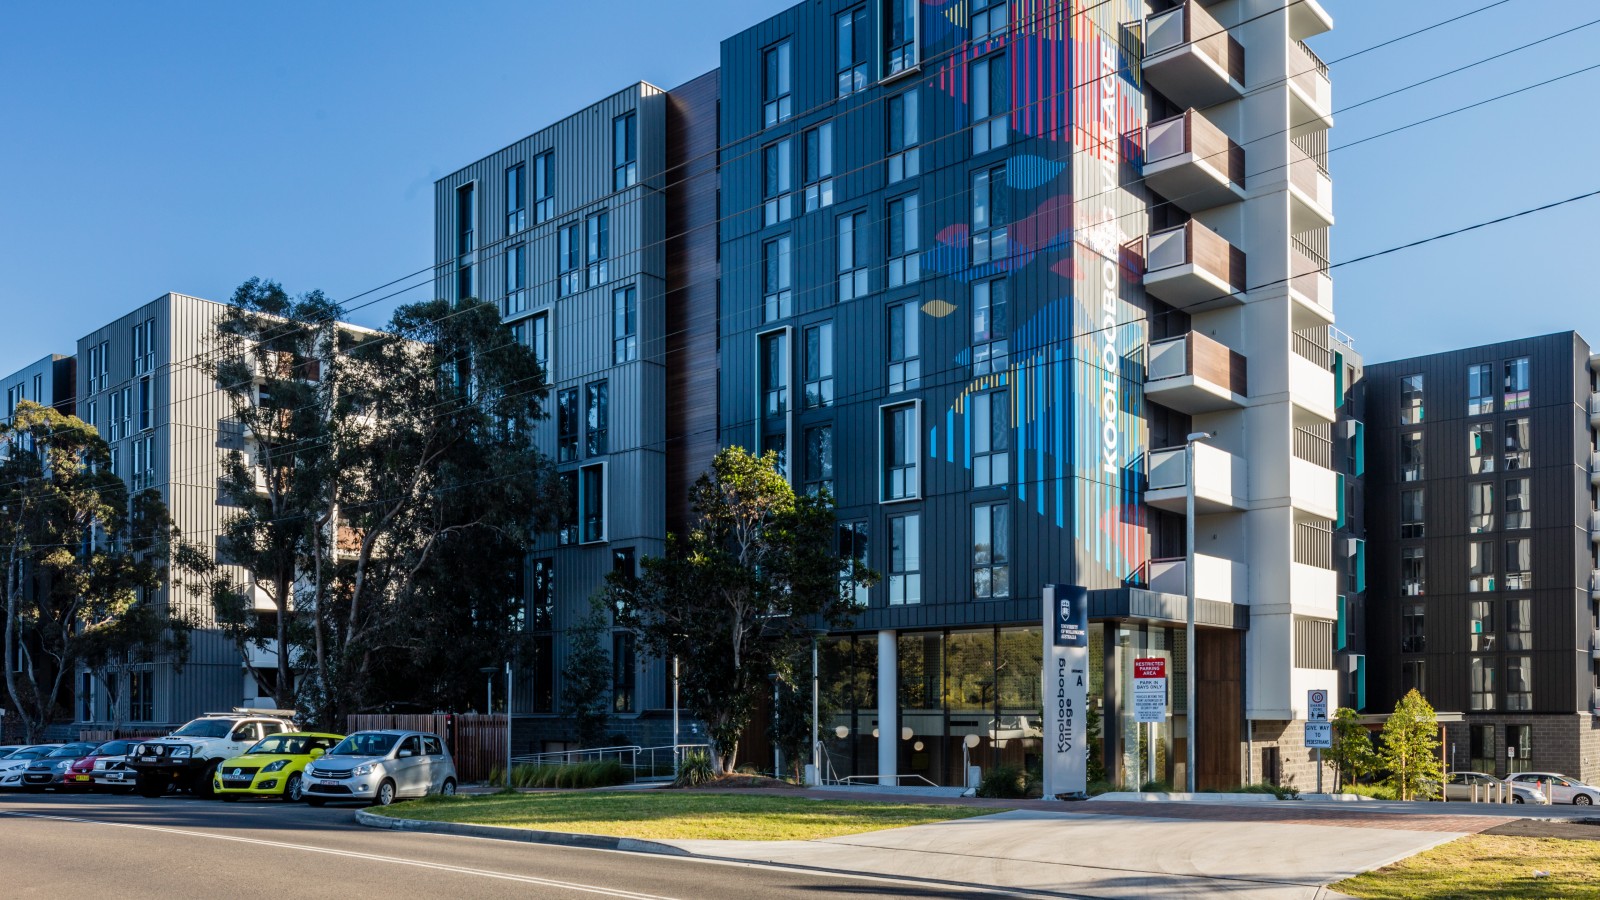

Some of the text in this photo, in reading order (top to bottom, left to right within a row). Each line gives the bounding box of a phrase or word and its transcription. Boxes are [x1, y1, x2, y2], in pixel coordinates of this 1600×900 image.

[1102, 40, 1116, 192] VILLAGE
[1057, 658, 1066, 753] Kooloobong
[1076, 675, 1083, 686] A
[1065, 698, 1073, 752] Village
